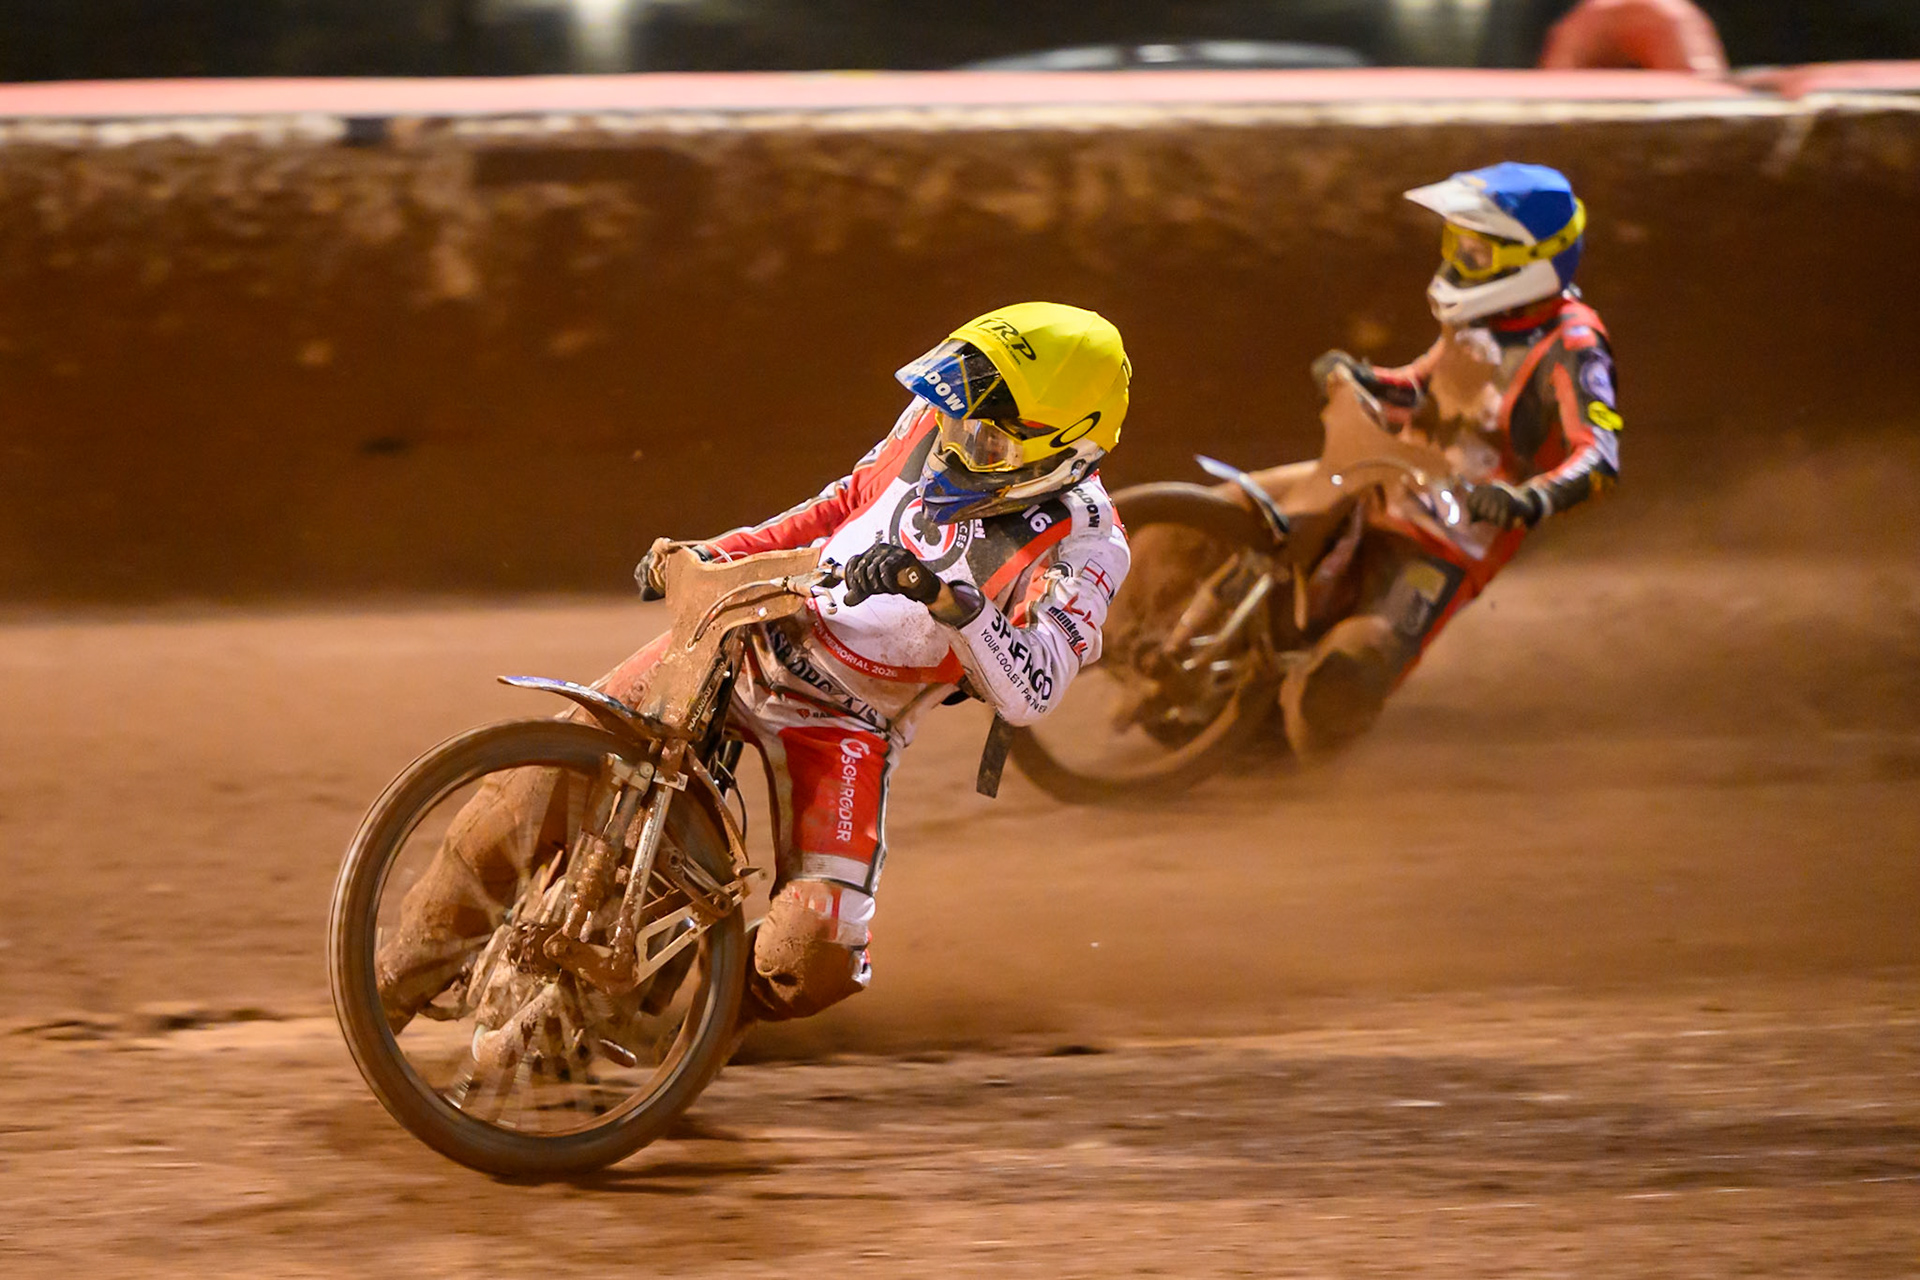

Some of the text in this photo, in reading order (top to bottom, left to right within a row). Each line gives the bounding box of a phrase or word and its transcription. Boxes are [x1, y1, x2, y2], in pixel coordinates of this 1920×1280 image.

[1021, 504, 1053, 533] 16
[823, 632, 870, 671] MEMORIAL
[980, 629, 1000, 654] YOUR
